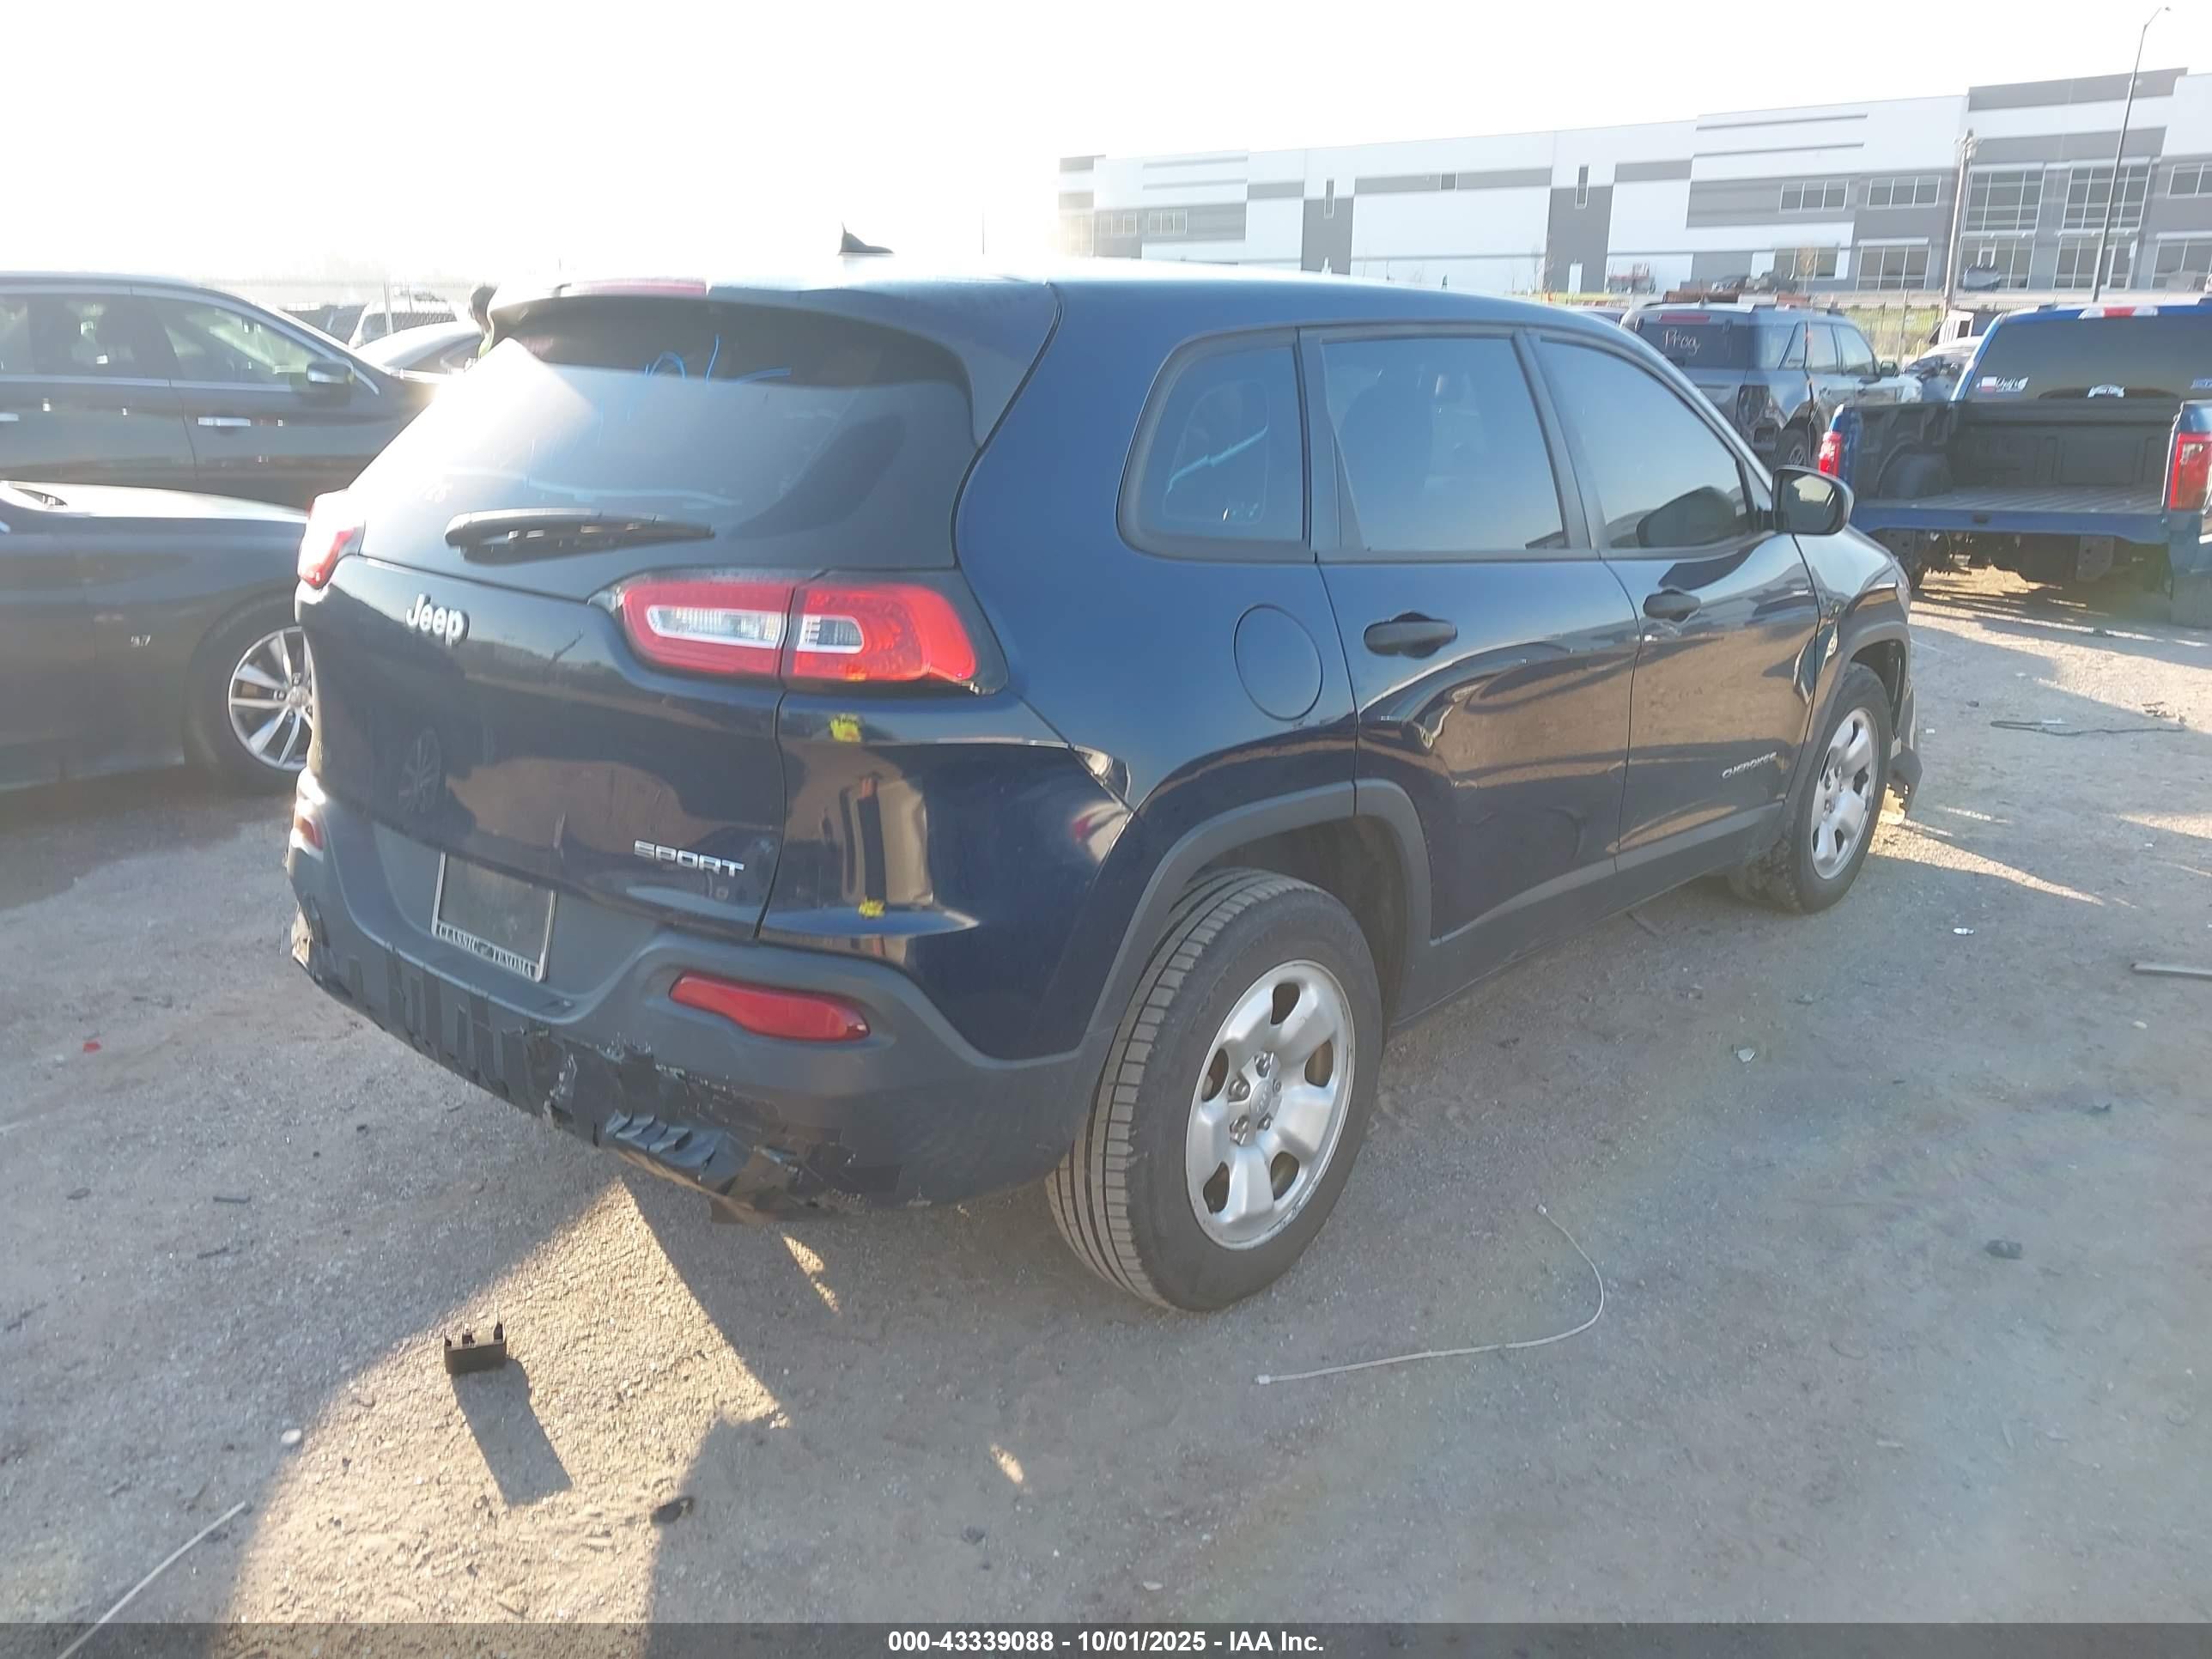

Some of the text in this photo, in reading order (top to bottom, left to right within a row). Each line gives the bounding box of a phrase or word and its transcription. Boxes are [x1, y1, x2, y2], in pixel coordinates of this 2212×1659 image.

[405, 592, 465, 647] Jeep
[1722, 751, 1778, 779] CHEROKEE
[634, 840, 745, 878] SPORT
